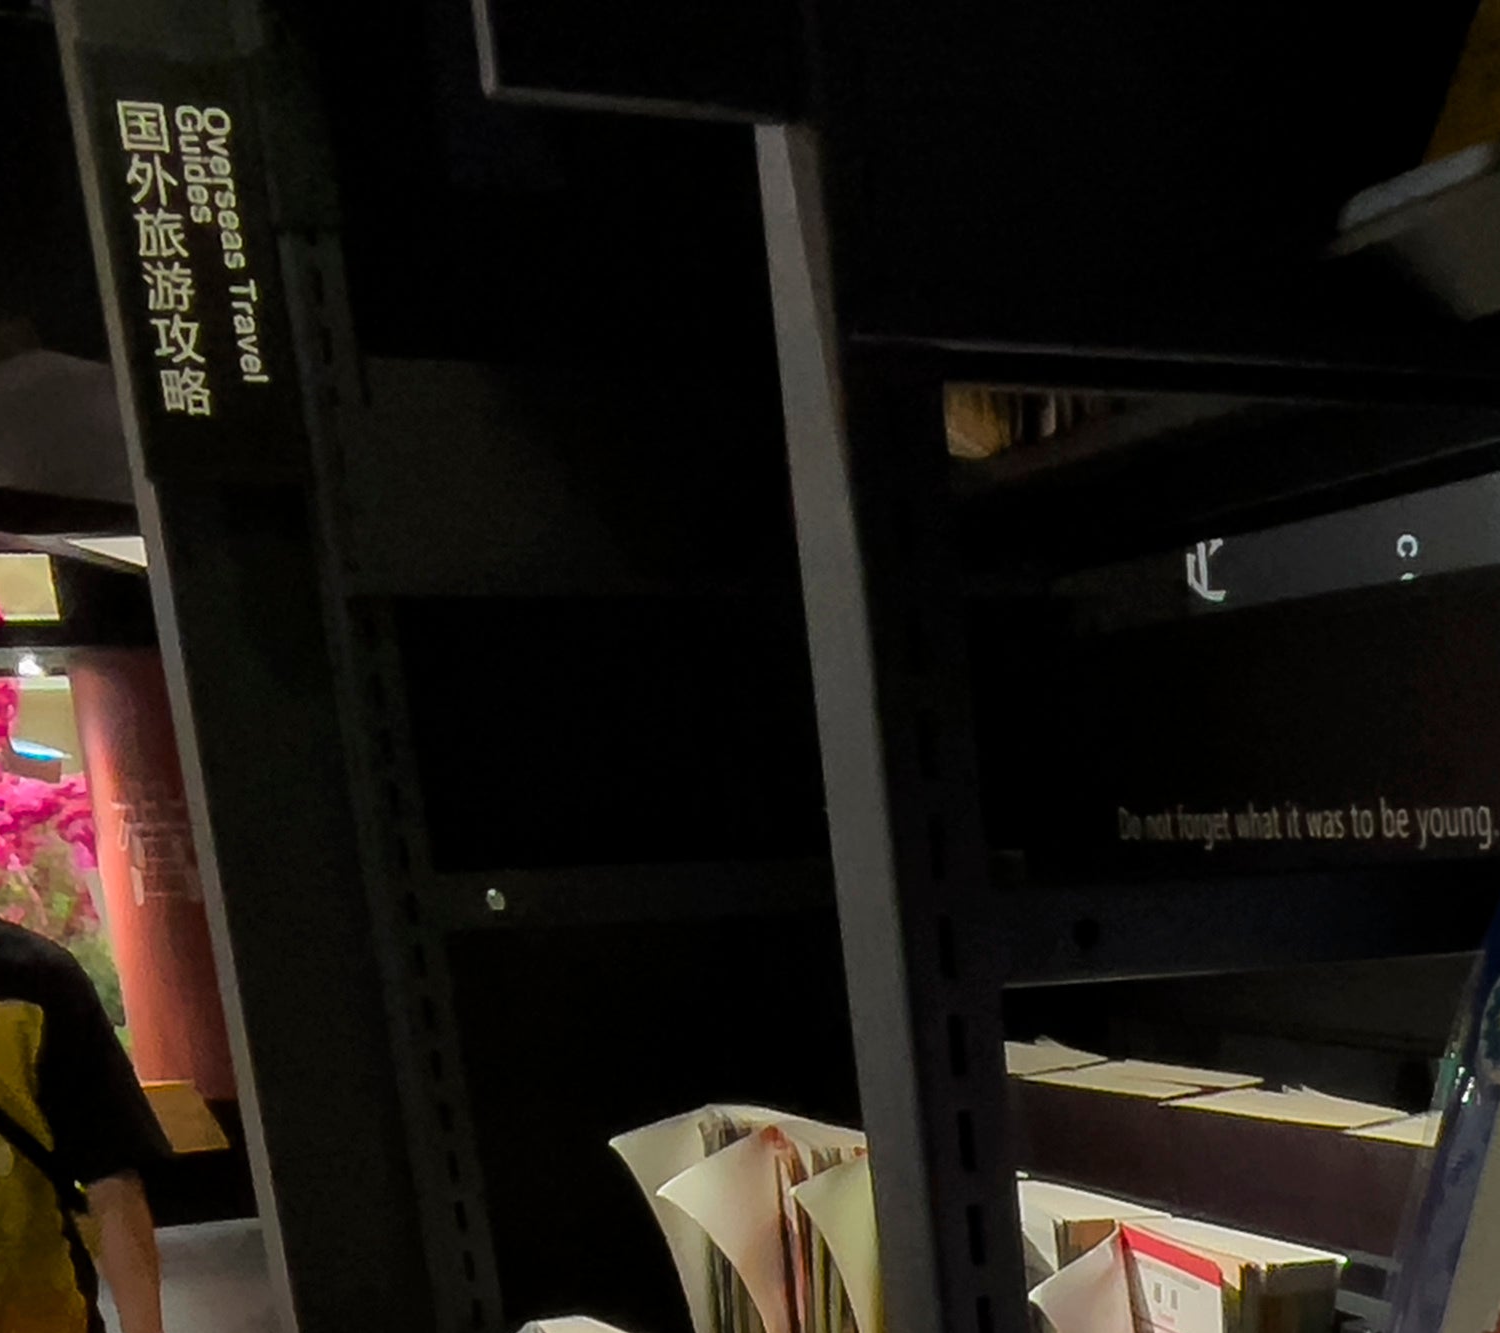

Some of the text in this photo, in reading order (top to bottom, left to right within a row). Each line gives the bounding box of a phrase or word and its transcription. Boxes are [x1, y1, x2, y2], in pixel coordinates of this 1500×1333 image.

[116, 99, 211, 417] 国外旅游攻略
[175, 105, 212, 224] Guides
[203, 107, 269, 384] Overseas Travel
[1118, 806, 1141, 839] Do
[1176, 804, 1232, 850] forget
[1235, 802, 1282, 839] what
[1285, 800, 1301, 839] it
[1306, 809, 1345, 839] was
[1351, 803, 1374, 838] to
[1380, 796, 1409, 838] be
[1415, 804, 1500, 850] young.
